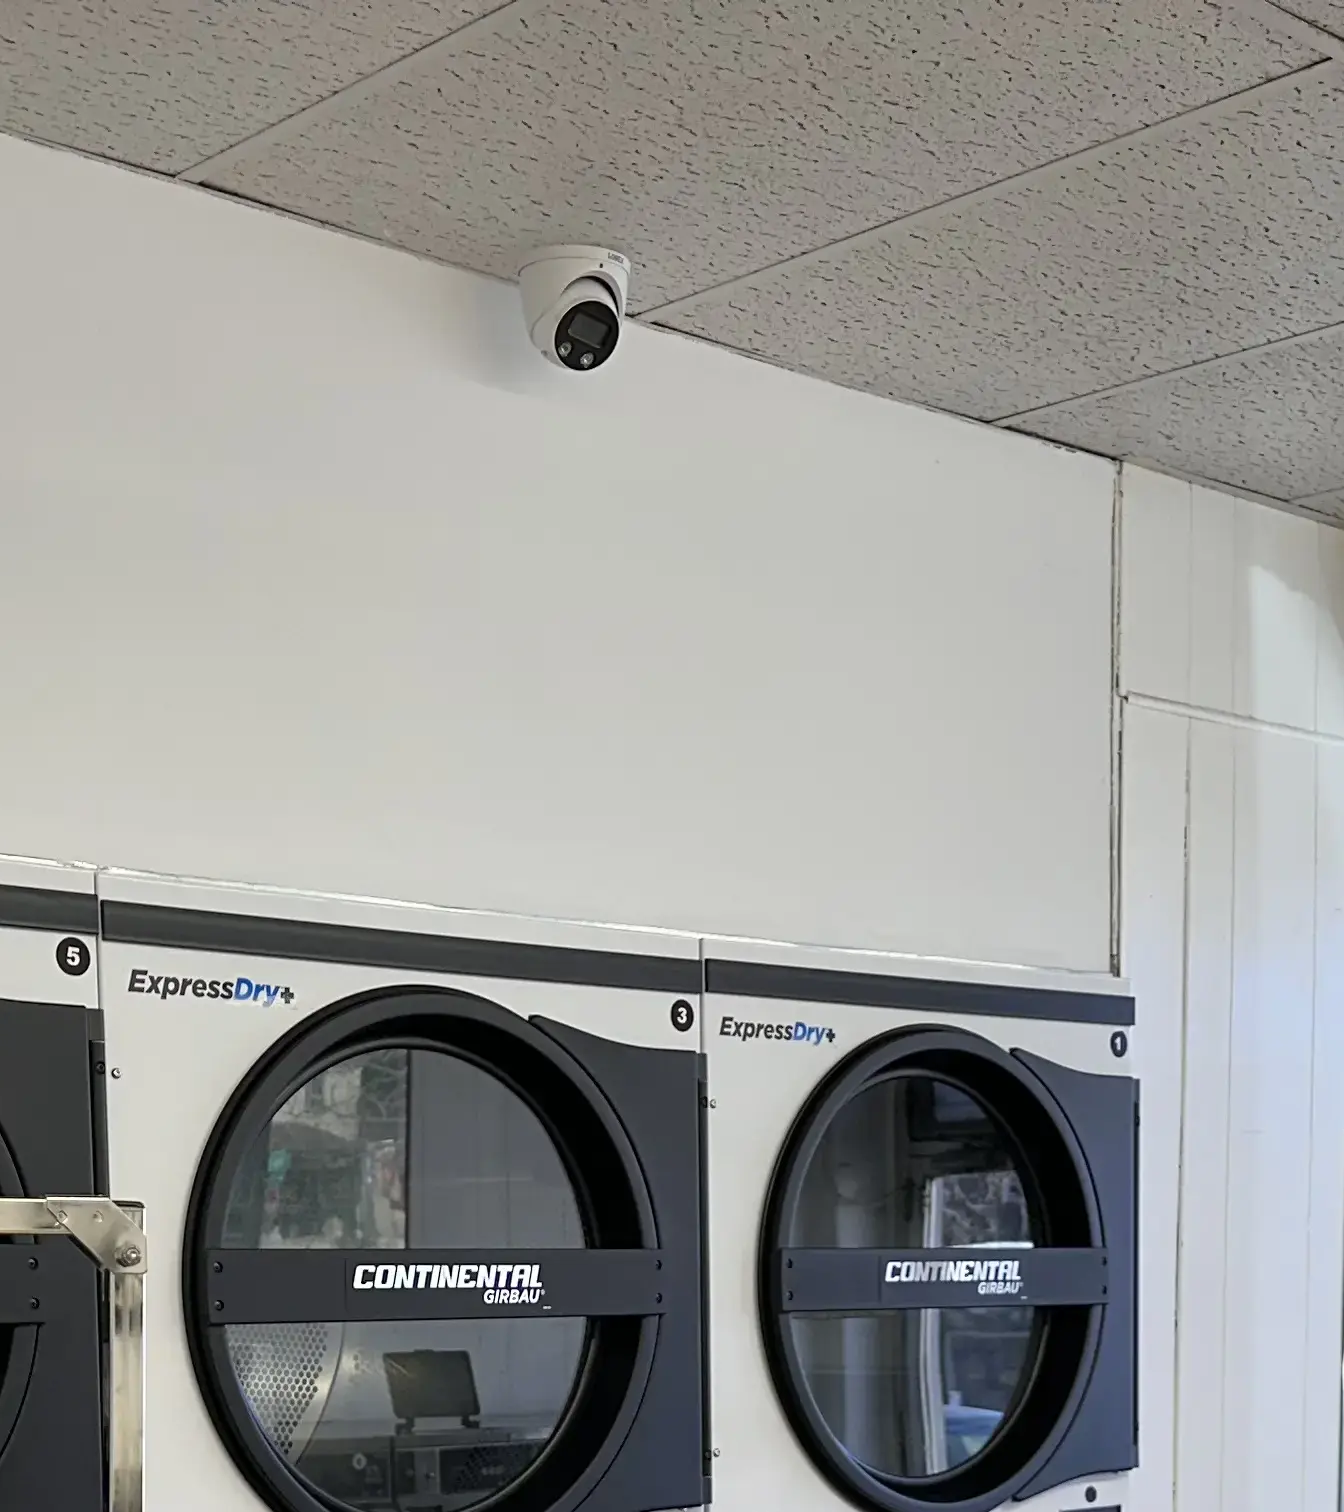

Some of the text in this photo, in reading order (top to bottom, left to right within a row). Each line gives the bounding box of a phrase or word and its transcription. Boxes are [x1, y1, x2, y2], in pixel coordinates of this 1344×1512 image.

[66, 946, 81, 967] 5
[128, 969, 294, 1008] ExpressDry+
[676, 1007, 687, 1025] 3
[719, 1017, 836, 1046] ExpressDry+
[1114, 1037, 1123, 1053] 1
[353, 1263, 543, 1289] CONTINENTAL
[885, 1260, 1021, 1283] CONTINENTAL
[483, 1289, 540, 1304] GIRBAU
[977, 1282, 1019, 1295] GIRBAU
